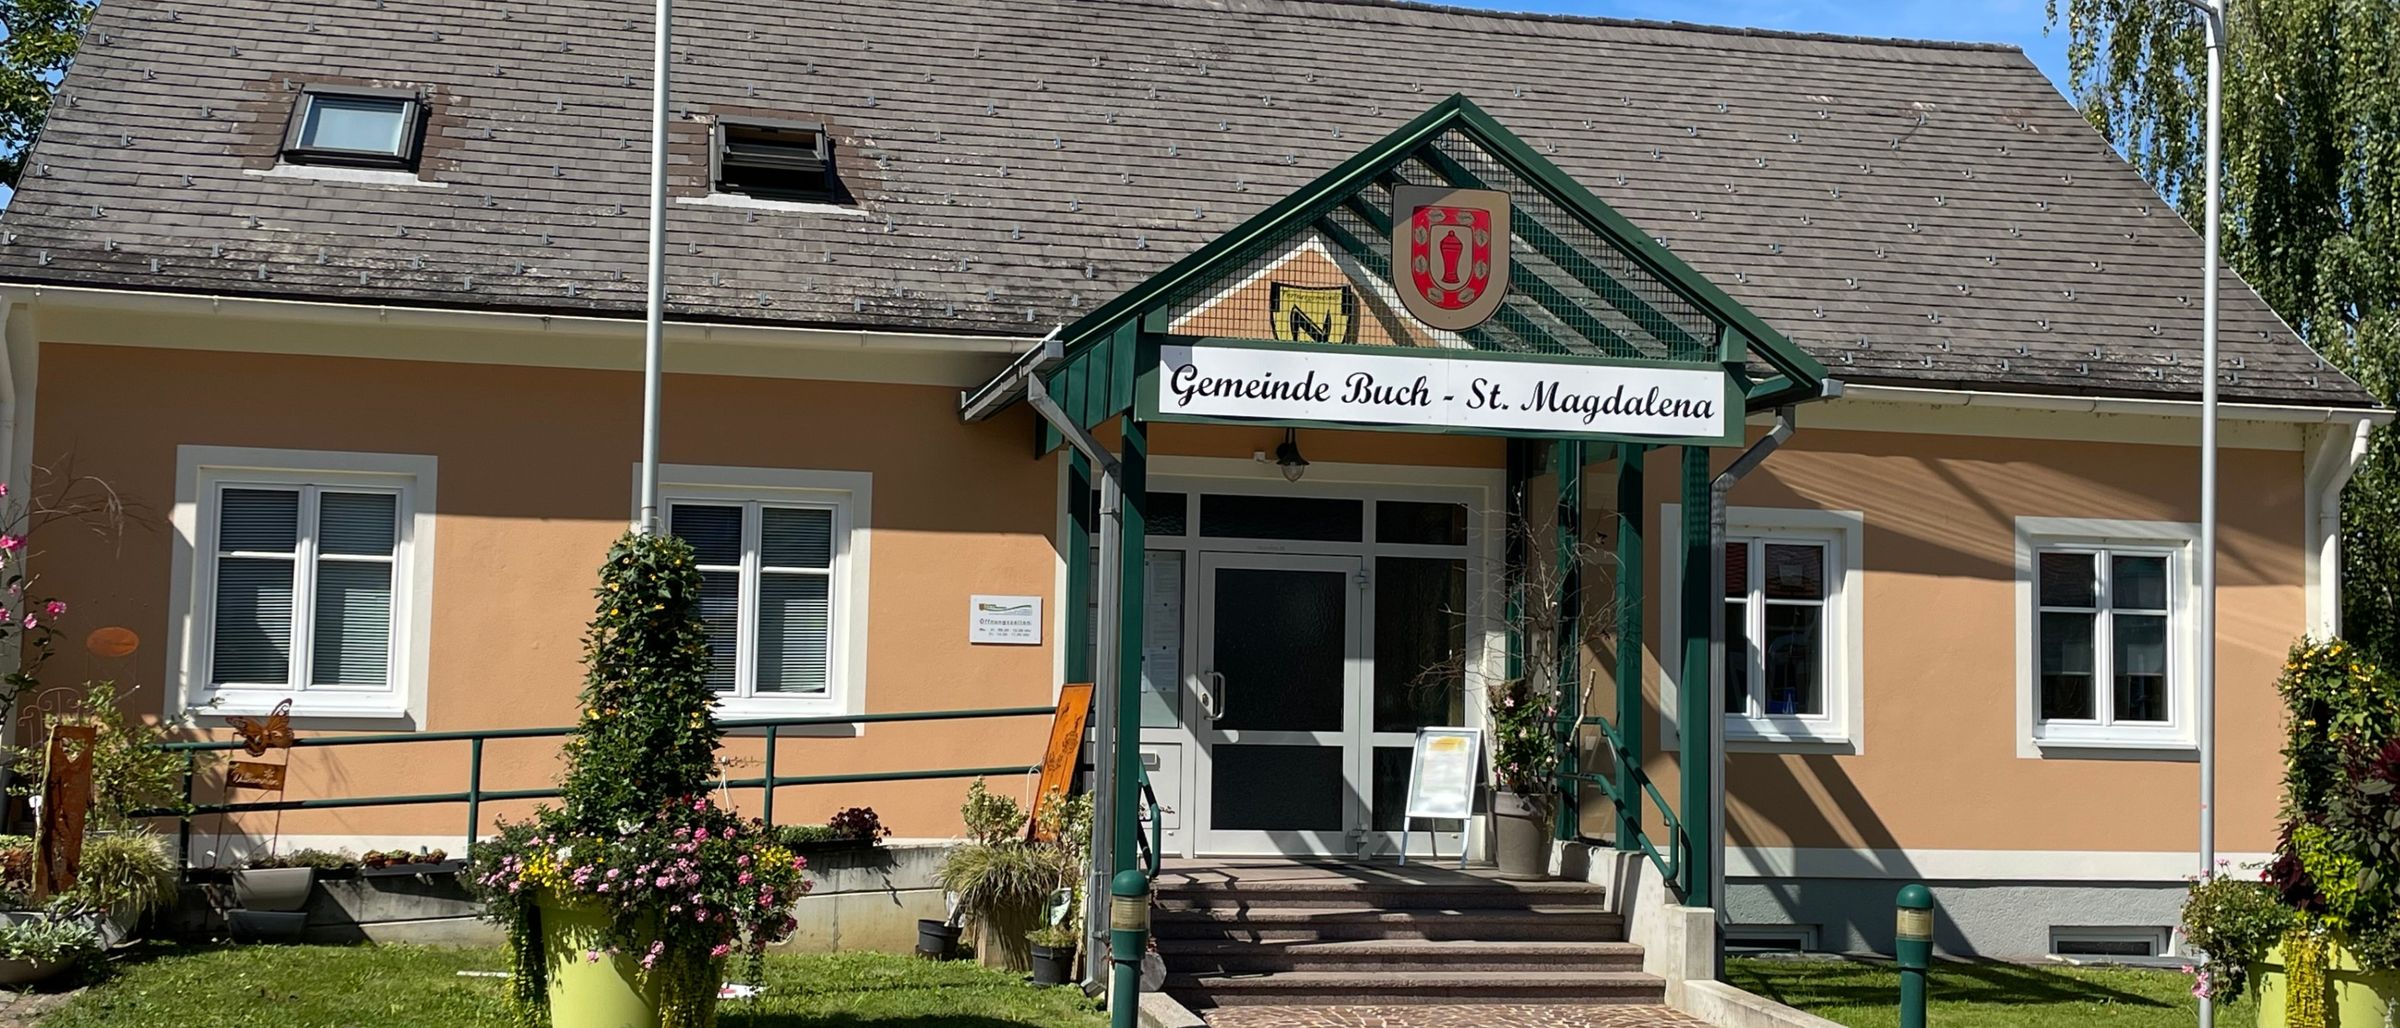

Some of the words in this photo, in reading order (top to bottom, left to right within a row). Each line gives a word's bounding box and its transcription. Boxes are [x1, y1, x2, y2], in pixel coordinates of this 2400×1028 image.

[1170, 363, 1331, 407] Gemeinde
[1342, 370, 1432, 407] Buch
[1466, 377, 1510, 411] St.
[1520, 380, 1715, 426] Magdalena
